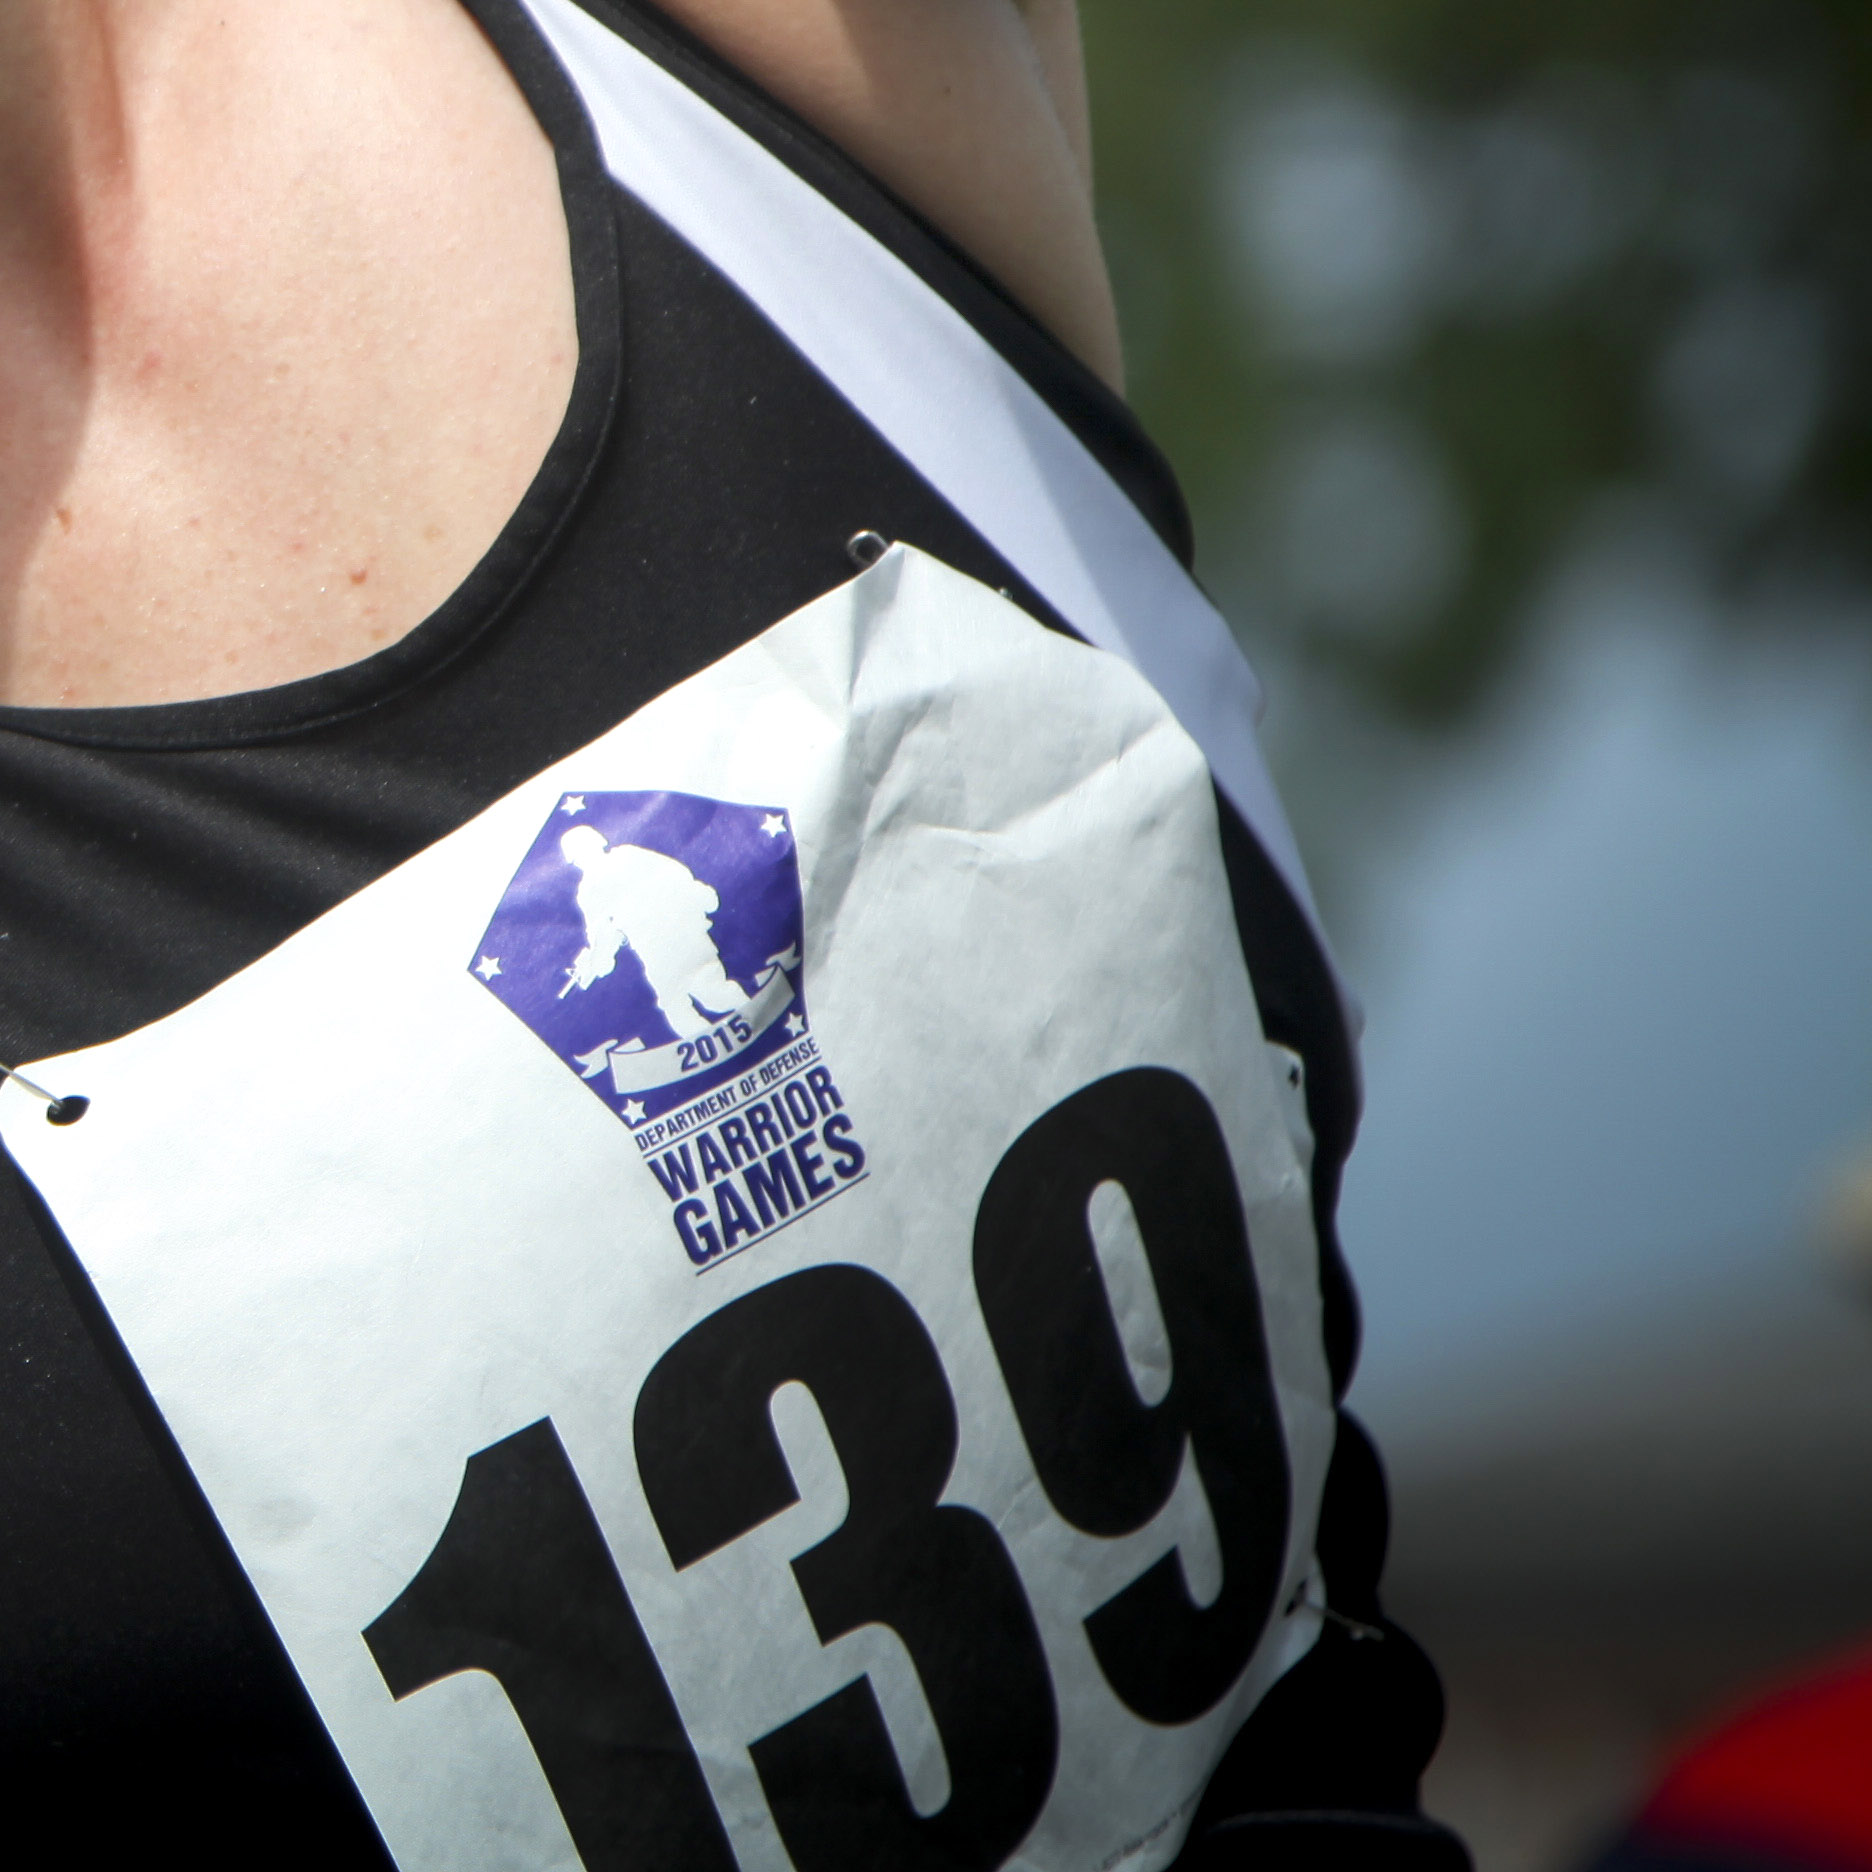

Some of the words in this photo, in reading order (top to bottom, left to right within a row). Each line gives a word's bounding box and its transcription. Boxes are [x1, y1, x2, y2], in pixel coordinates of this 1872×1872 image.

[634, 1087, 738, 1151] DEPARTMENT
[740, 1075, 760, 1097] OF
[759, 1036, 820, 1086] DEFENSE
[677, 1015, 753, 1072] 2015
[647, 1065, 844, 1203] WARRIOR
[673, 1113, 866, 1266] GAMES
[361, 1066, 1292, 1872] 139
